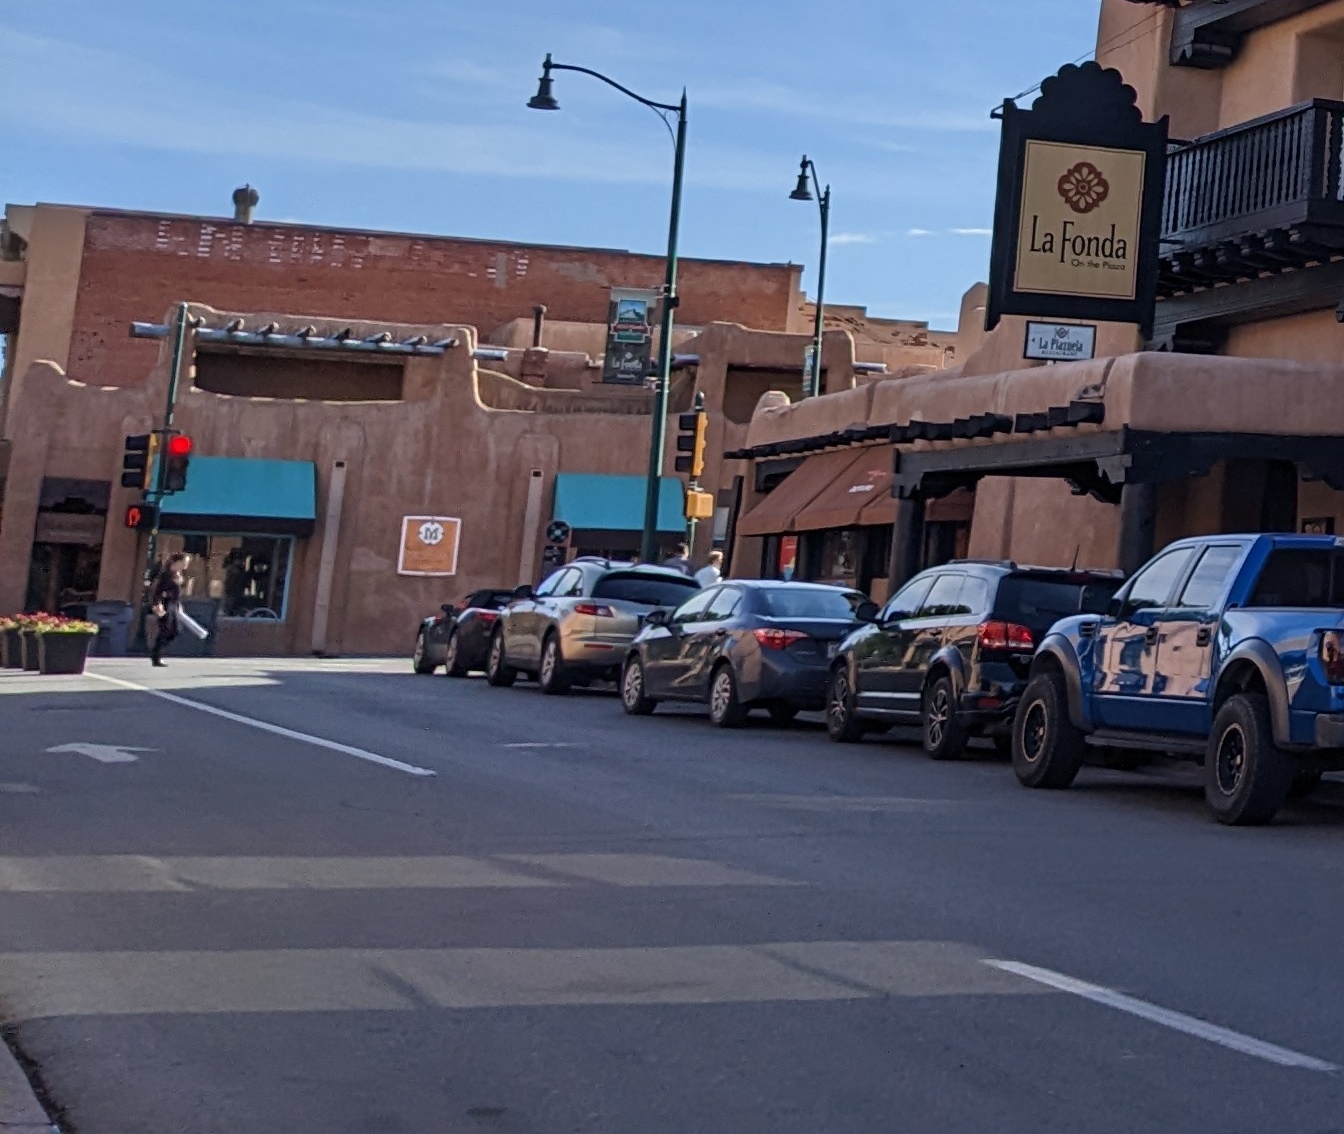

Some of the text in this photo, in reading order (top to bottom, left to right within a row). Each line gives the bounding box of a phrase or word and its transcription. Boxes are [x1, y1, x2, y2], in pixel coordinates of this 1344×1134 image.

[1029, 214, 1127, 263] La Fonda
[1071, 258, 1126, 271] On the Plaza
[1038, 336, 1049, 350] La
